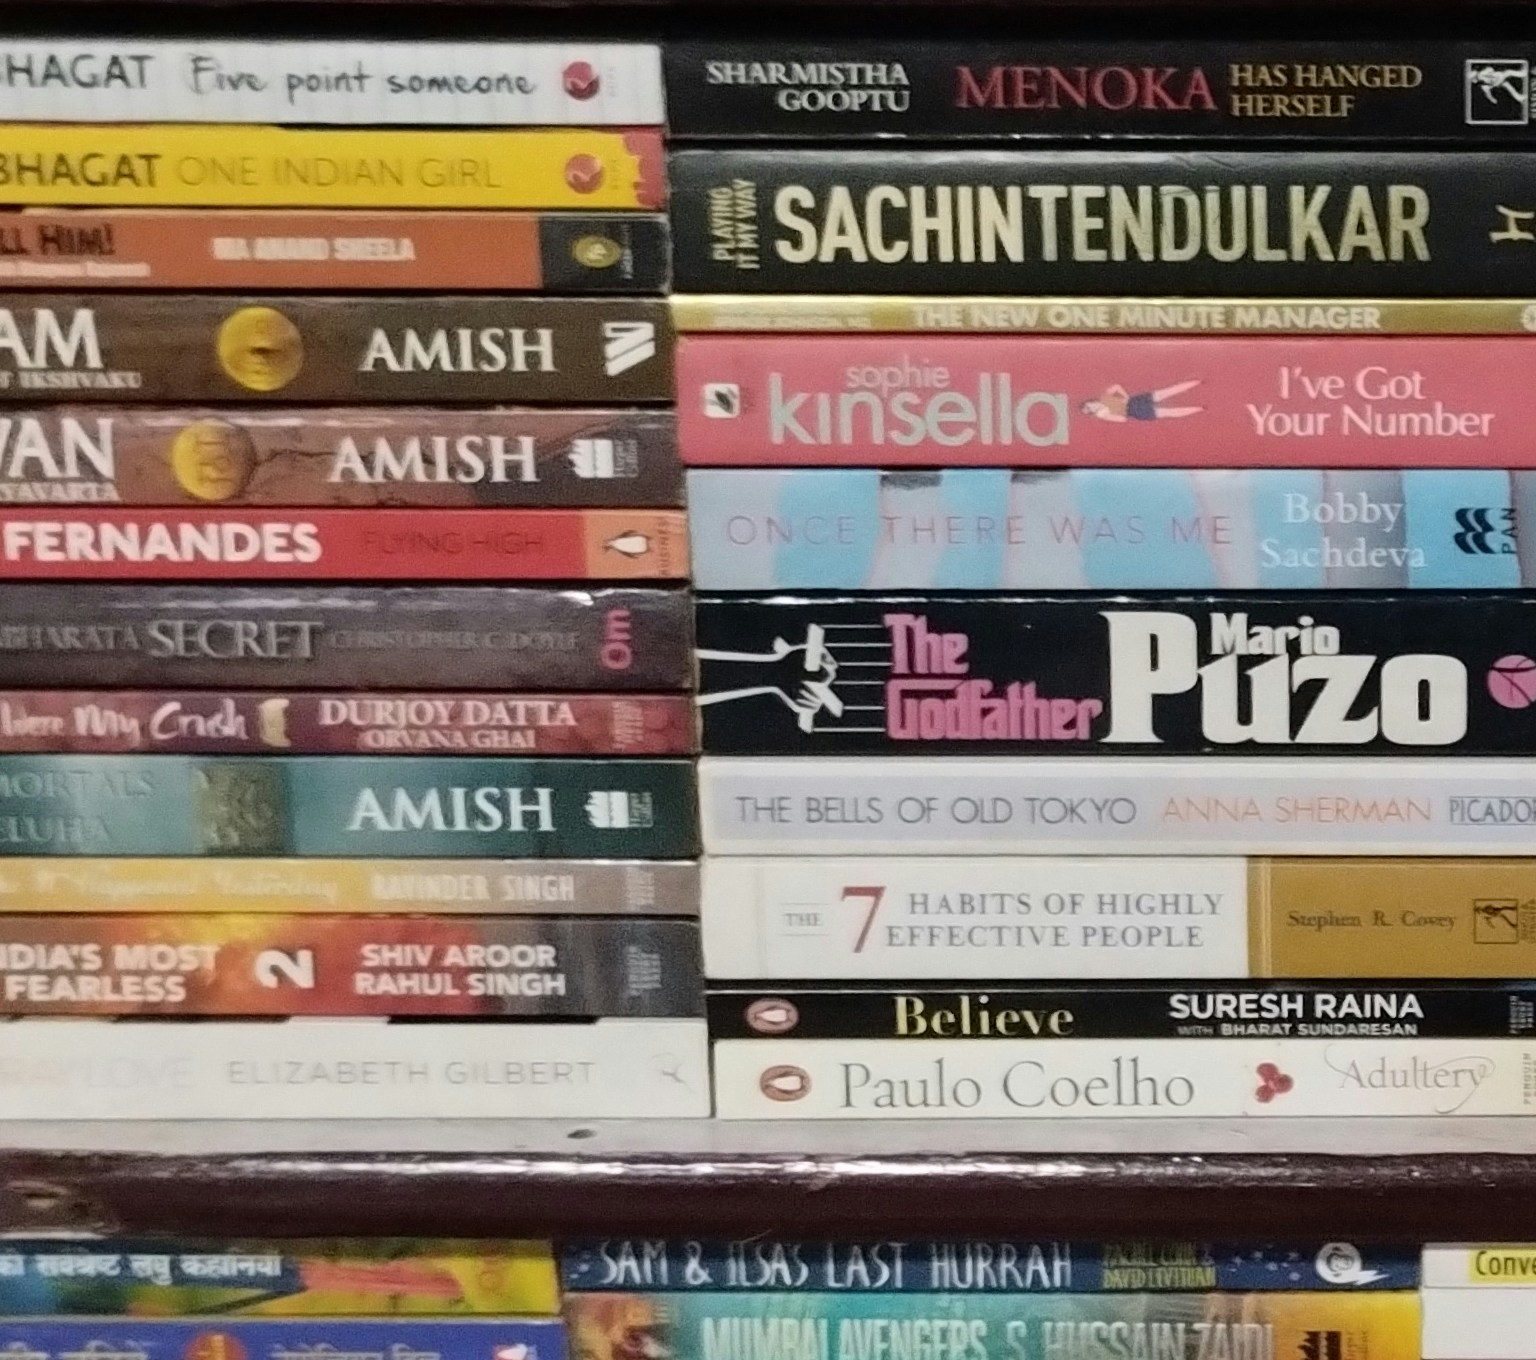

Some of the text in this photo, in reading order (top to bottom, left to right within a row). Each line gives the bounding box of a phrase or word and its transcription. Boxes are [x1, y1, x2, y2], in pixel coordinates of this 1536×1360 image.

[190, 55, 536, 105] Five point someone
[706, 61, 908, 88] SHARMISTHA
[954, 67, 1214, 112] MENOKA
[777, 87, 910, 113] GOOPTU
[359, 328, 558, 372] AMISH
[1279, 367, 1425, 402] I've Got
[1247, 403, 1496, 439] Your Number
[4, 523, 323, 560] FERNANDES
[884, 613, 968, 676] The
[1211, 612, 1339, 657] Mario
[1099, 610, 1468, 746] Puzo
[884, 677, 1102, 742] Godfather
[347, 788, 557, 832] AMISH
[736, 796, 1137, 825] THE BELLS OF OLD TOKYO
[908, 892, 1224, 917] HABITS OF HIGHLY
[885, 925, 1205, 949] EFFECTIVE PEOPLE
[361, 944, 557, 969] SHIV AROOR
[354, 972, 566, 997] RAHUL SINGH
[893, 996, 1074, 1037] Believe
[1169, 993, 1424, 1019] SURESH RAINA
[838, 1058, 1195, 1110] Paulo Coelho
